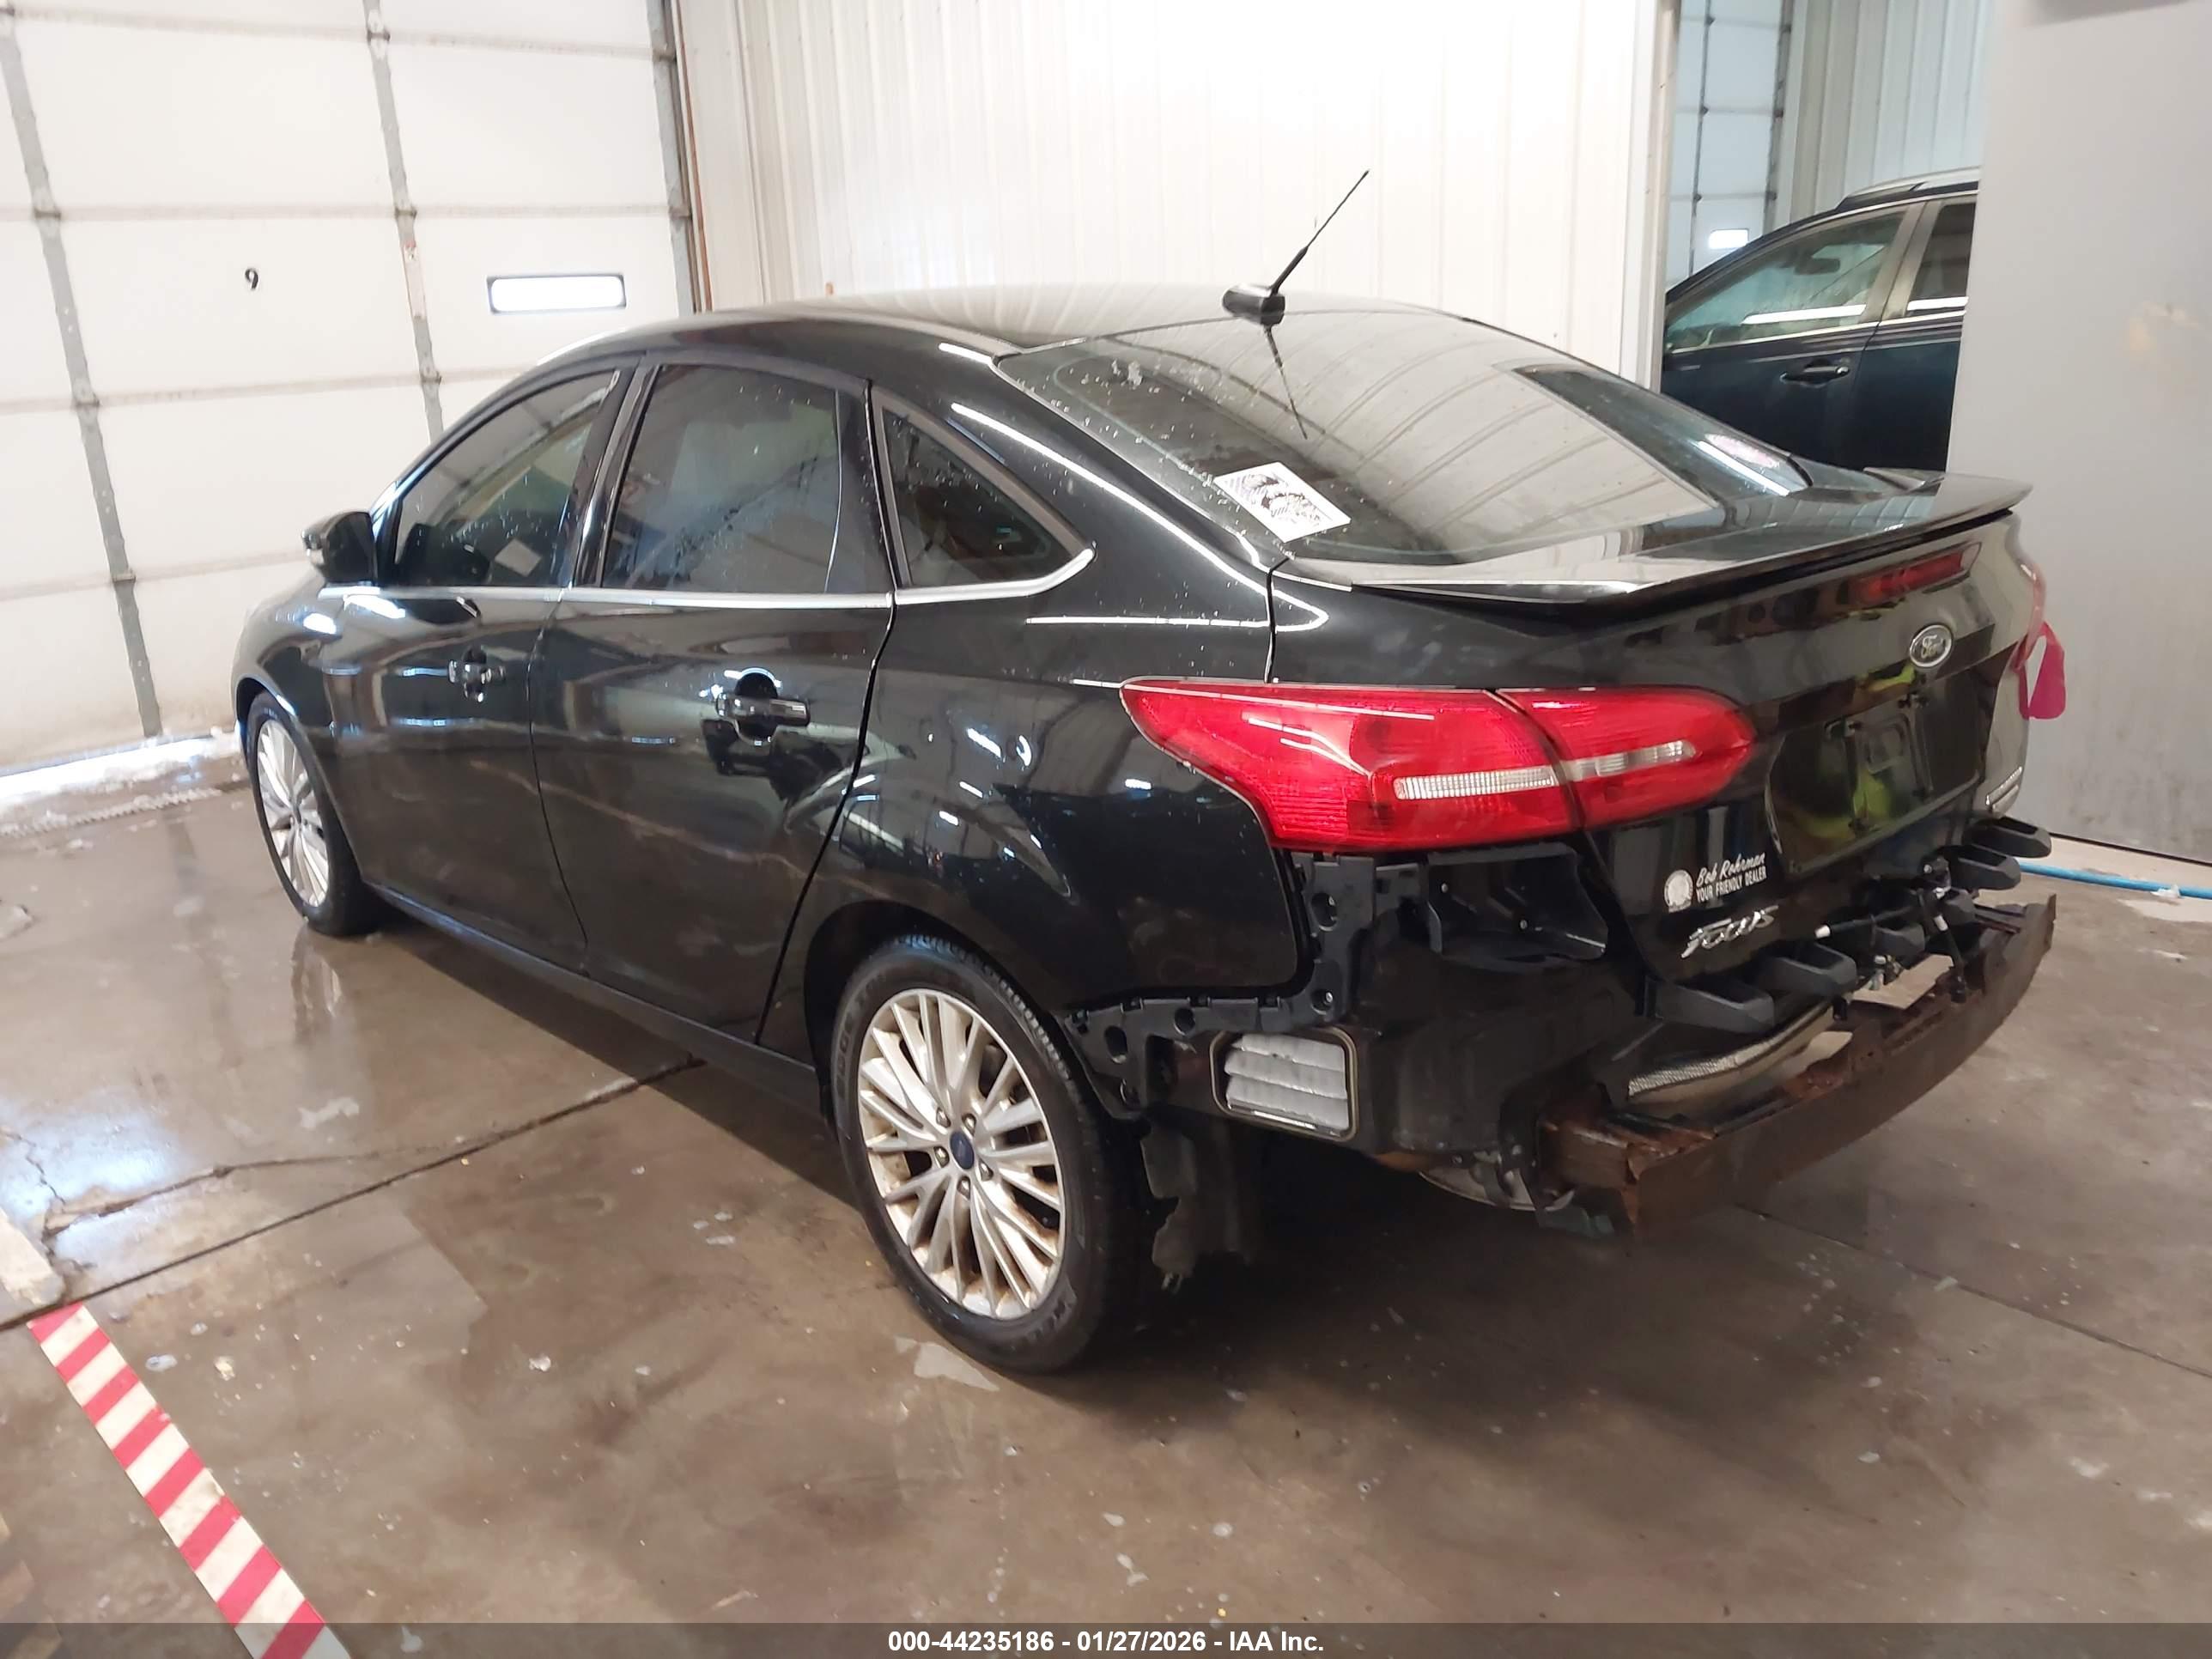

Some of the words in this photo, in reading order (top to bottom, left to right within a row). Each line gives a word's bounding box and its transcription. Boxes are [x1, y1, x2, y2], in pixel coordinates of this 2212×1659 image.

[244, 267, 259, 290] 9
[1696, 862, 1718, 887] Bob
[1696, 886, 1714, 902] YOUR
[1716, 876, 1743, 897] FRIENDLY
[1745, 866, 1767, 887] DEALER
